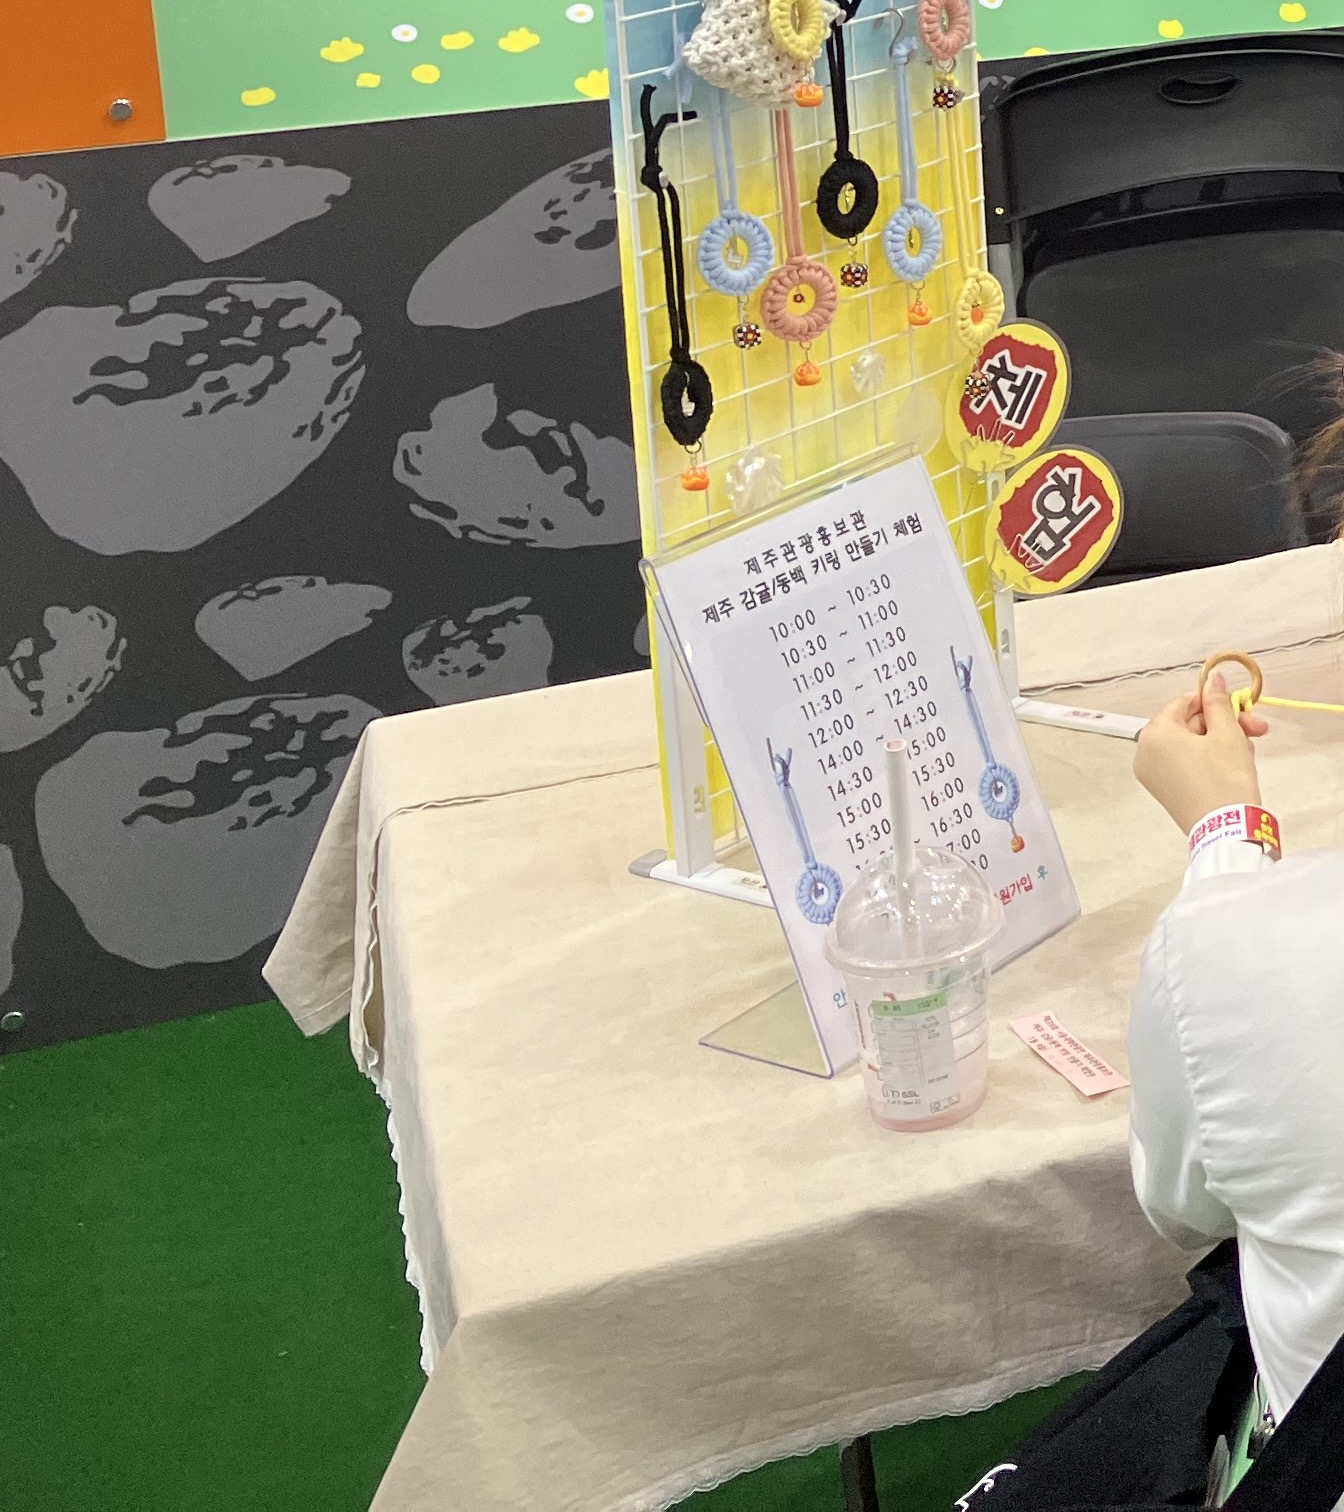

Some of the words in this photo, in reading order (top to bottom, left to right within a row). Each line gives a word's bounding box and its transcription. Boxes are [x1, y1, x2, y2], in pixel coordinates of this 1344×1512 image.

[702, 597, 735, 624] 제주
[739, 566, 808, 611] 감귤/동백
[811, 549, 842, 575] 키링
[845, 527, 889, 562] 만들기
[893, 513, 923, 537] 체험
[769, 609, 816, 642] 10:00
[847, 574, 891, 606] 10:30
[781, 635, 827, 668] 10:30
[858, 600, 898, 630] 11:00
[792, 662, 835, 694] 11:00
[865, 627, 906, 657] 11:30
[800, 688, 843, 721] 11:30
[874, 651, 917, 683] 12:00
[808, 714, 854, 748] 12:00
[885, 675, 928, 709] 12:30
[818, 740, 863, 774] 14:00
[894, 701, 937, 734] 14:30
[827, 767, 873, 802] 14:30
[837, 792, 882, 827] 15:00
[912, 752, 955, 786] 15:30
[846, 818, 891, 854] 15:30
[921, 778, 964, 811] 16:00
[930, 803, 973, 837] 16:30
[945, 828, 981, 853] 7:00
[994, 874, 1033, 905] 원가입
